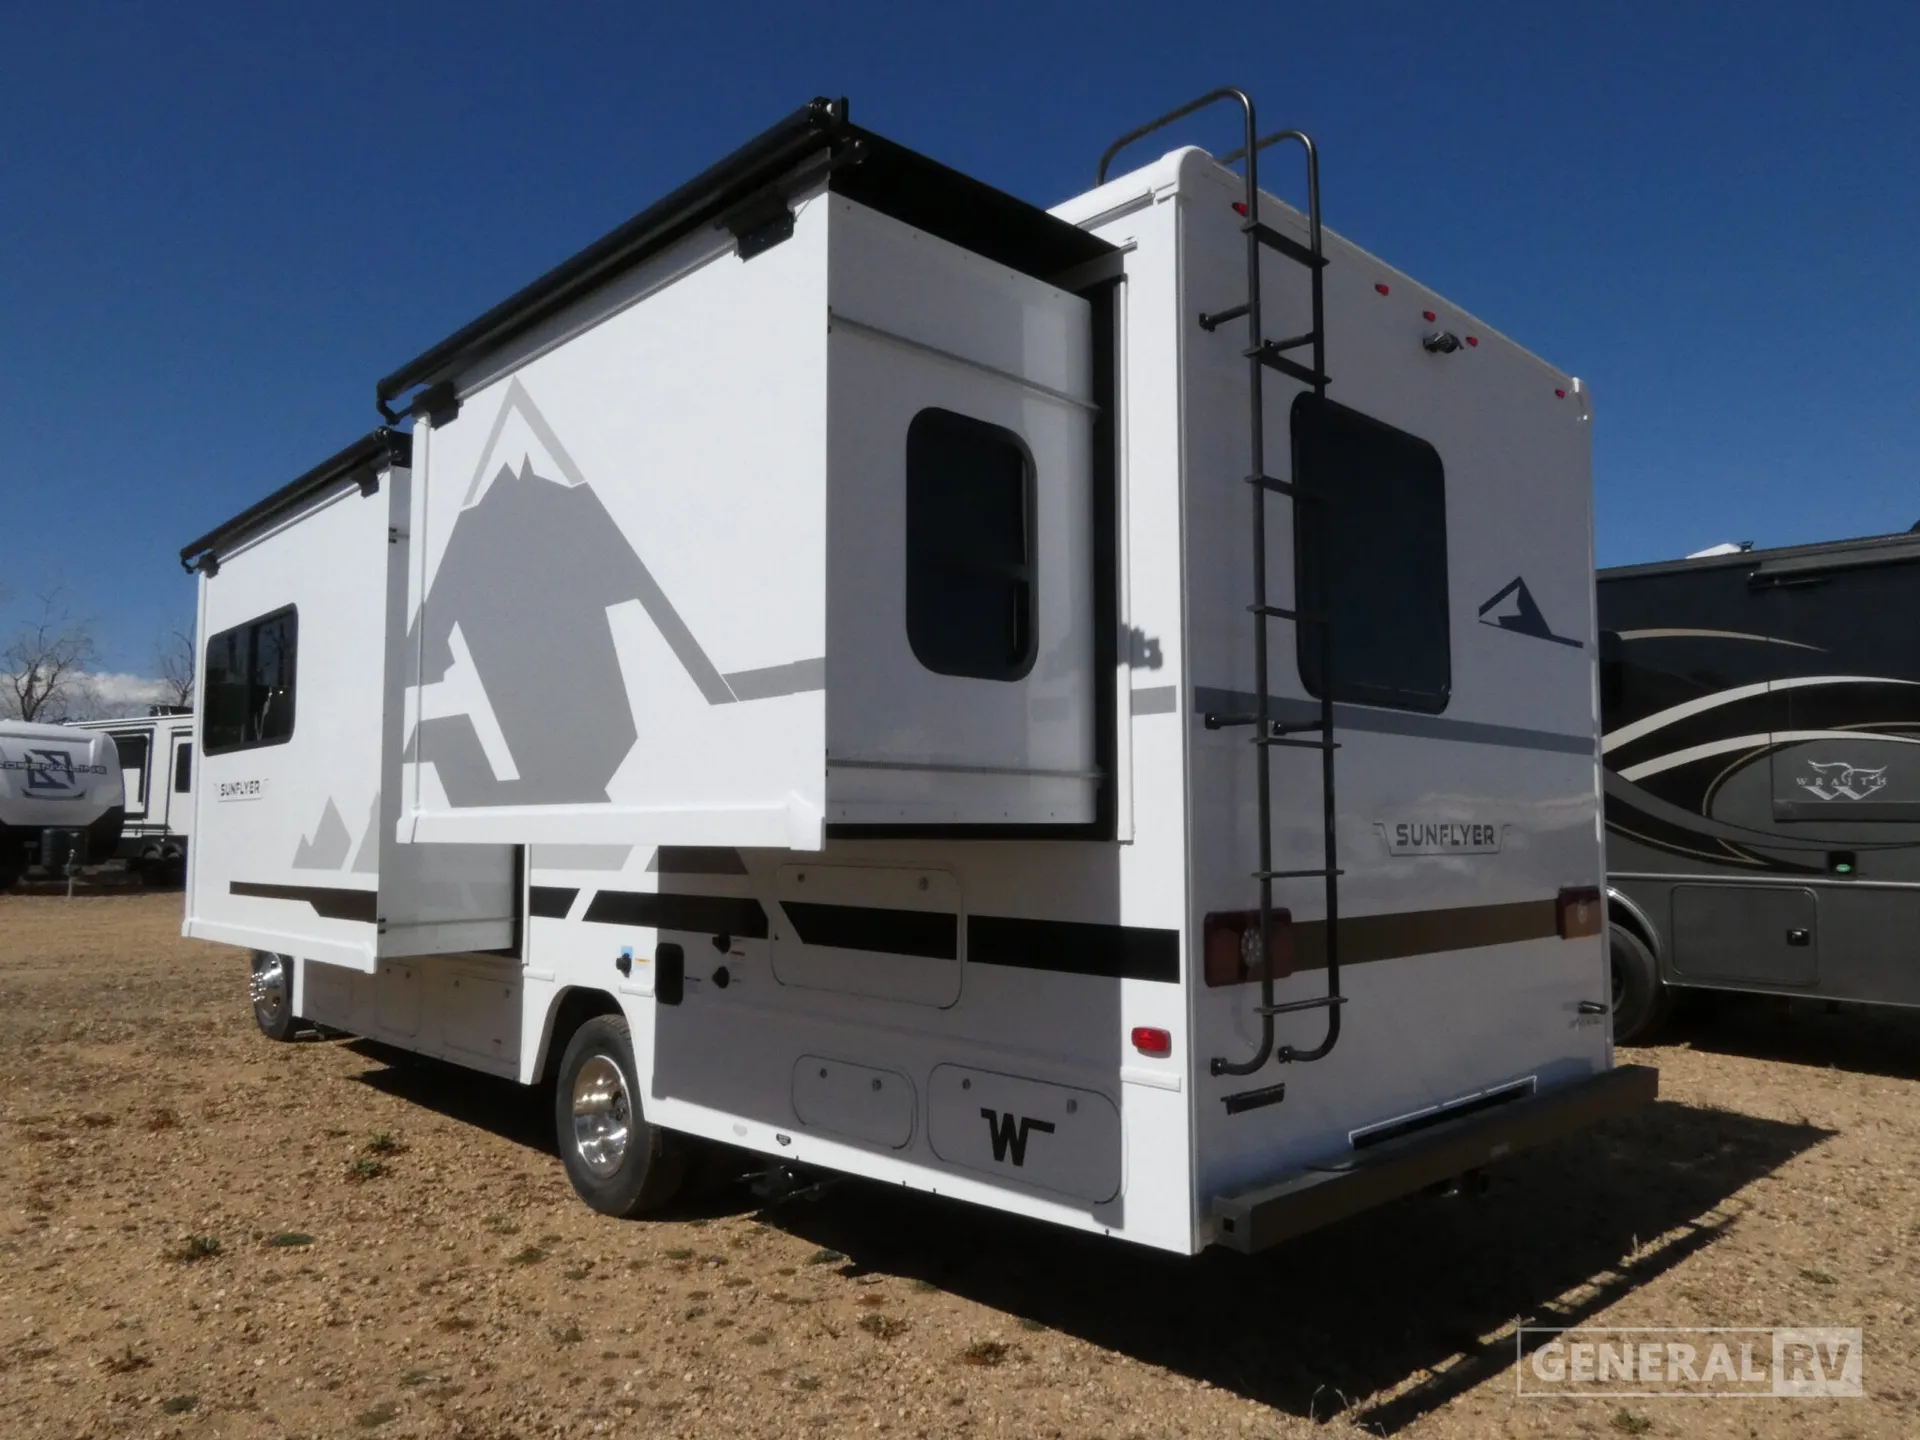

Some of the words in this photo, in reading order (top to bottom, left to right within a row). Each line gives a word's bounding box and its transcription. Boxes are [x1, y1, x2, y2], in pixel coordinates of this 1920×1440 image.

[220, 780, 260, 796] SUNFLYER
[1796, 776, 1887, 786] WRAITH
[1396, 823, 1495, 846] SUNFLYER
[980, 1107, 1055, 1167] W
